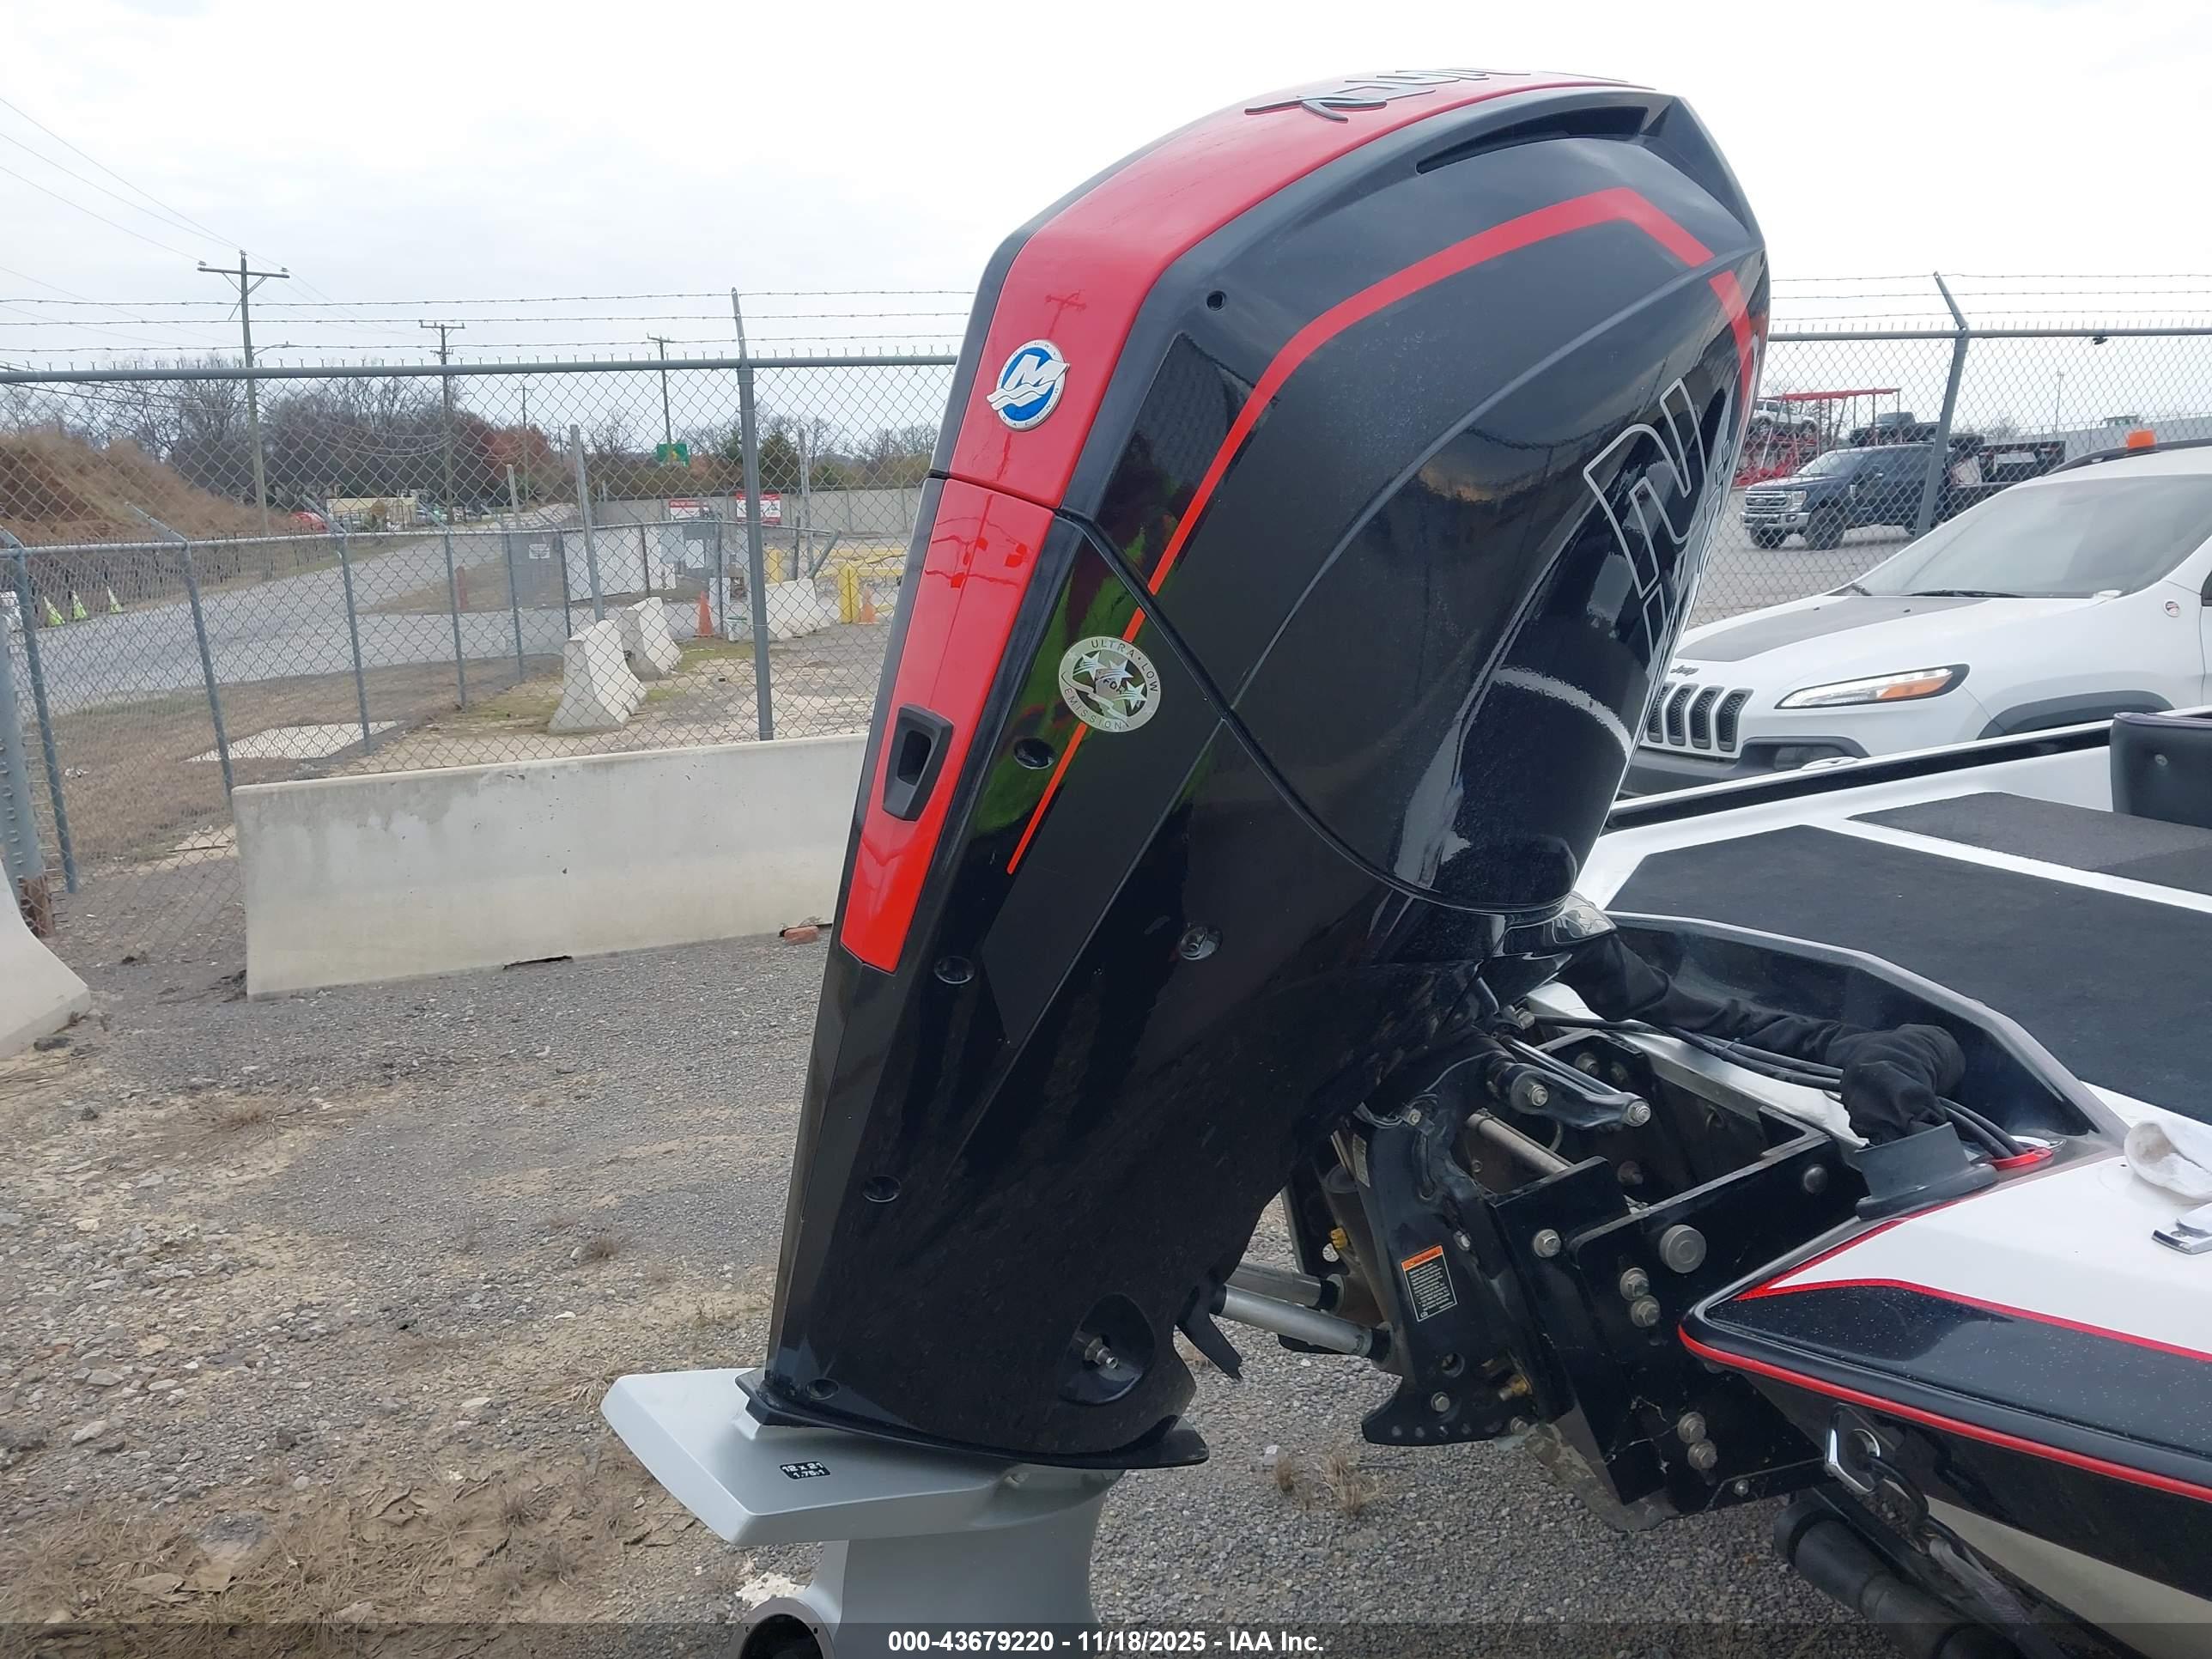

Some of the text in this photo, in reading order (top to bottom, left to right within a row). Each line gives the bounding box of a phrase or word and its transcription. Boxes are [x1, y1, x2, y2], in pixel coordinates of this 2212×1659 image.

[1090, 638, 1158, 692] ULTRA LOW
[1064, 687, 1122, 730] EMISSION
